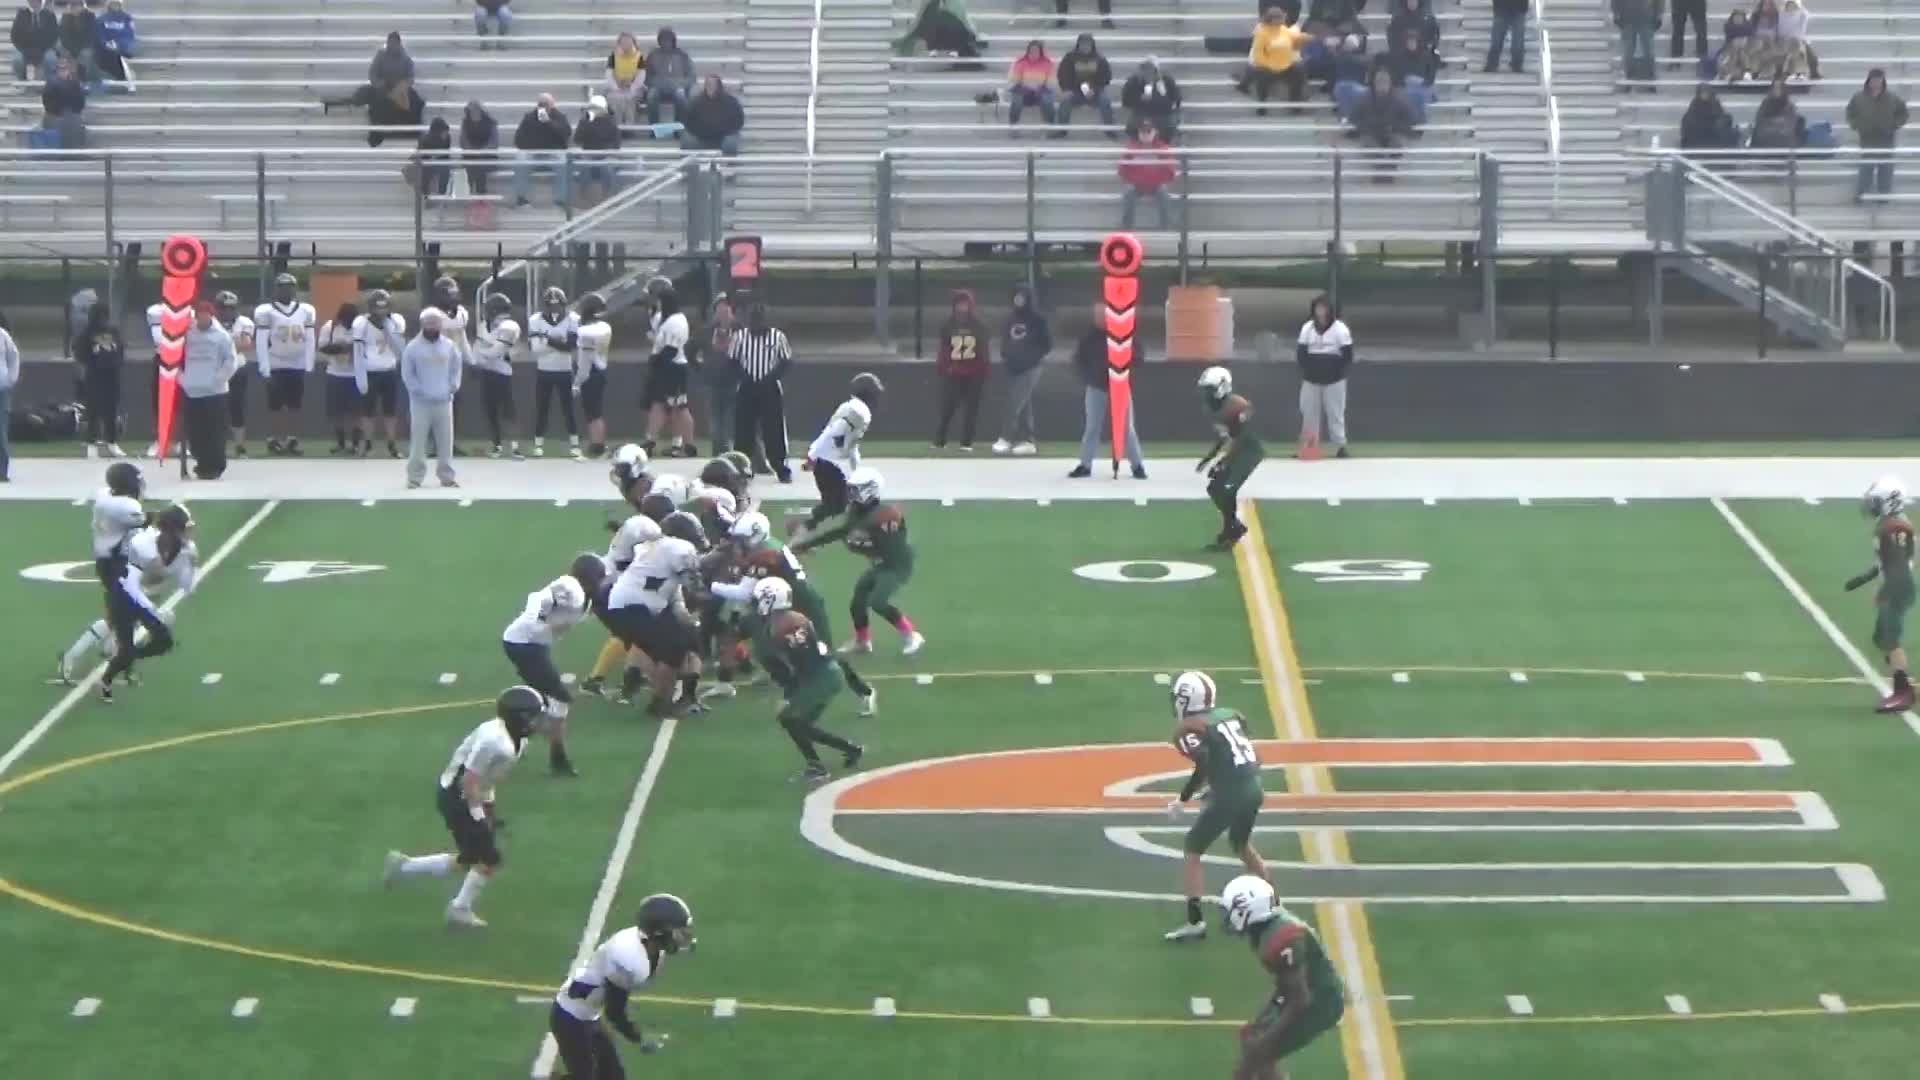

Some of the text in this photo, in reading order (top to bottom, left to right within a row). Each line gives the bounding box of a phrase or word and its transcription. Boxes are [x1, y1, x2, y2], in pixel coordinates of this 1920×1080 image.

[729, 242, 759, 278] 2
[951, 335, 976, 360] 22
[1179, 732, 1201, 753] 15
[1216, 719, 1257, 767] 15
[1280, 947, 1294, 966] 7
